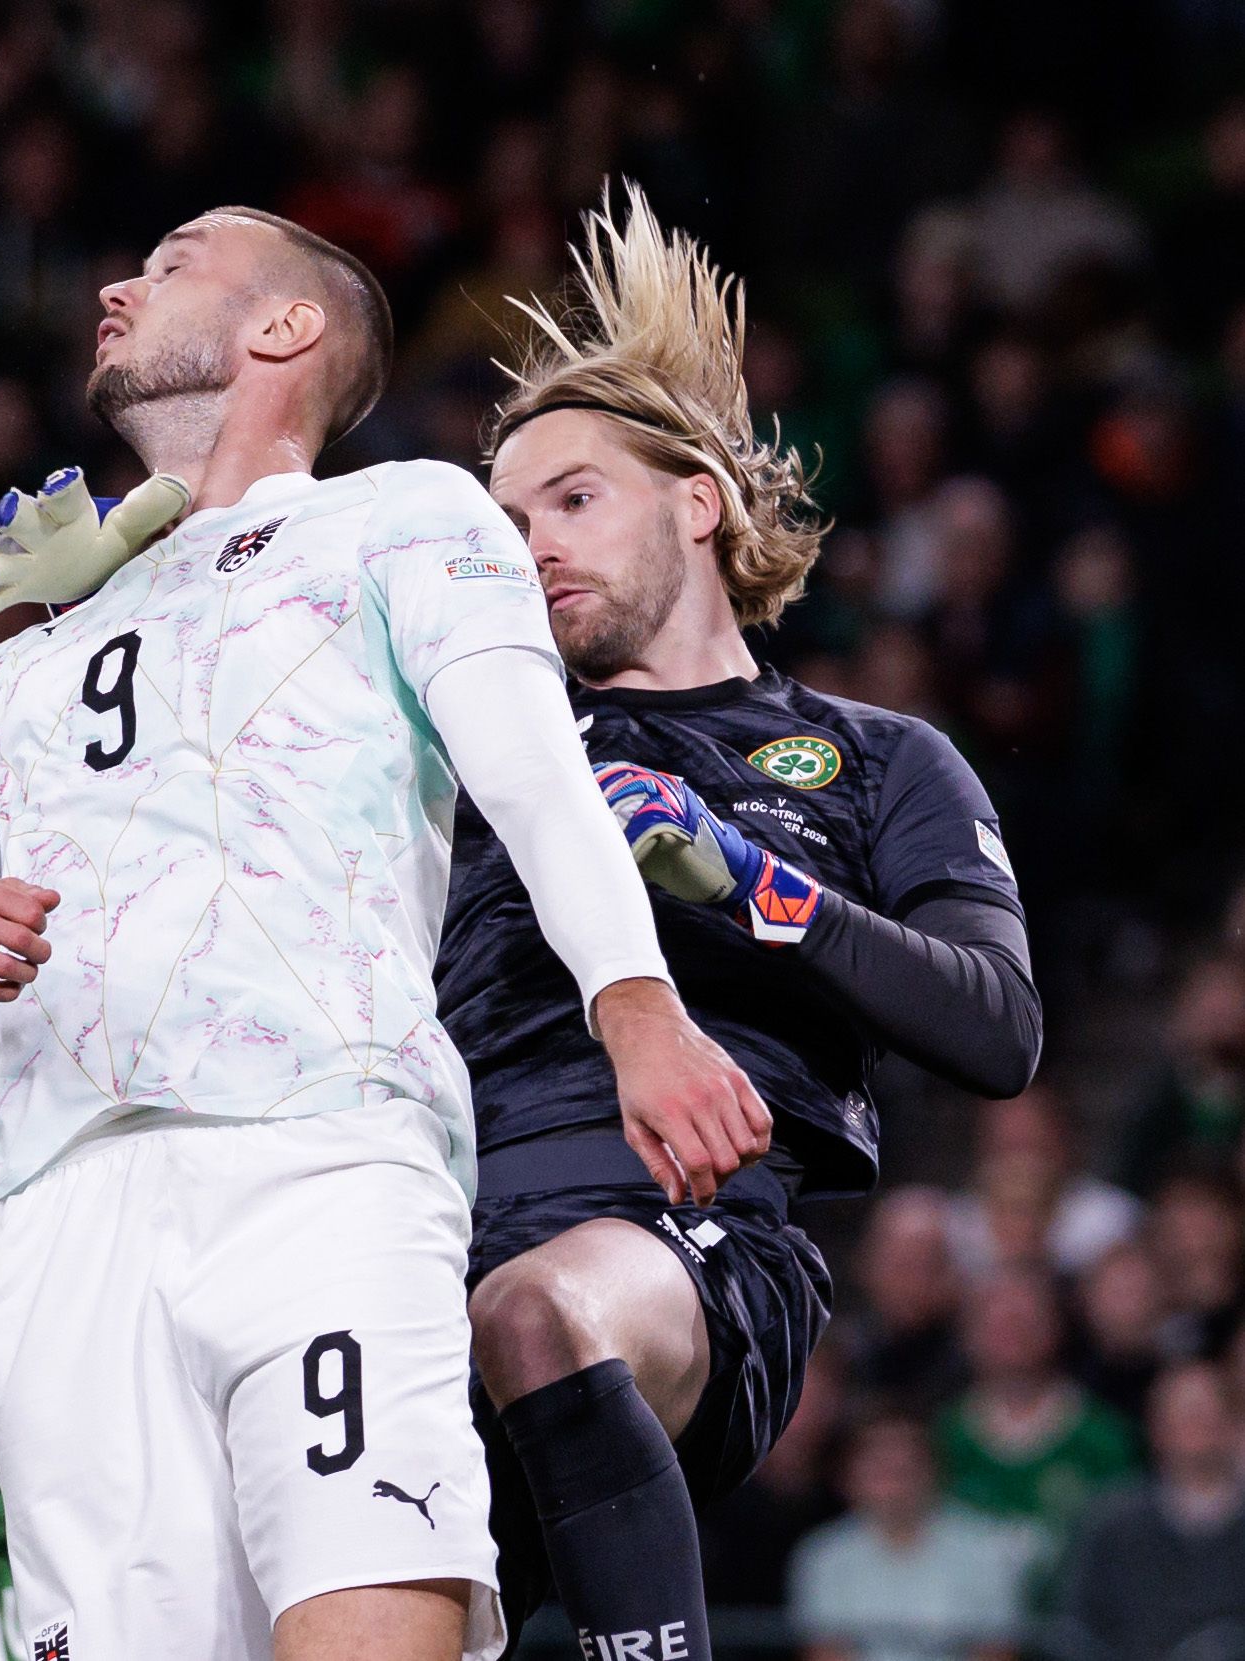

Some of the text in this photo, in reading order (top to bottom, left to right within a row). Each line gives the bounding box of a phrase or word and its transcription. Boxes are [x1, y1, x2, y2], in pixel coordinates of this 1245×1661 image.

[82, 628, 142, 772] 9
[758, 741, 833, 759] IRELAND
[777, 798, 786, 807] V
[802, 827, 828, 846] 2026
[303, 1329, 365, 1476] 9
